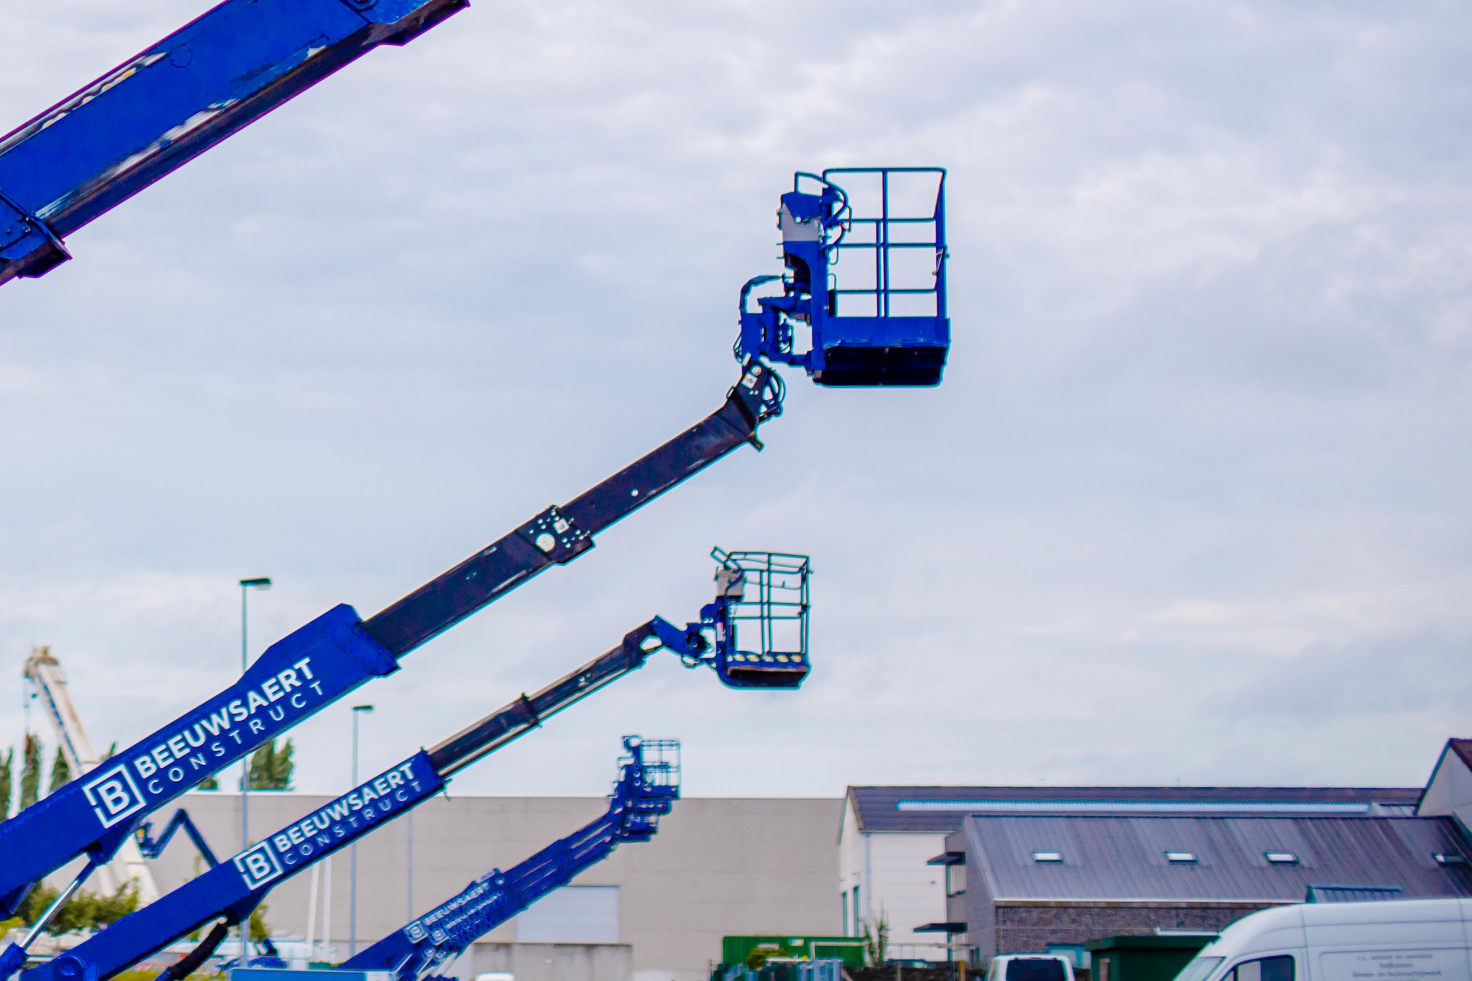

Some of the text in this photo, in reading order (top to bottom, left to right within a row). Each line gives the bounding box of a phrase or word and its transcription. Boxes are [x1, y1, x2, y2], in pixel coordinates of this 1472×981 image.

[133, 657, 313, 779] BEEUWSAERT
[148, 681, 323, 795] CONSTRUCT
[274, 762, 415, 853] BEEUWSAERT
[284, 781, 422, 865] CONSTRUCT
